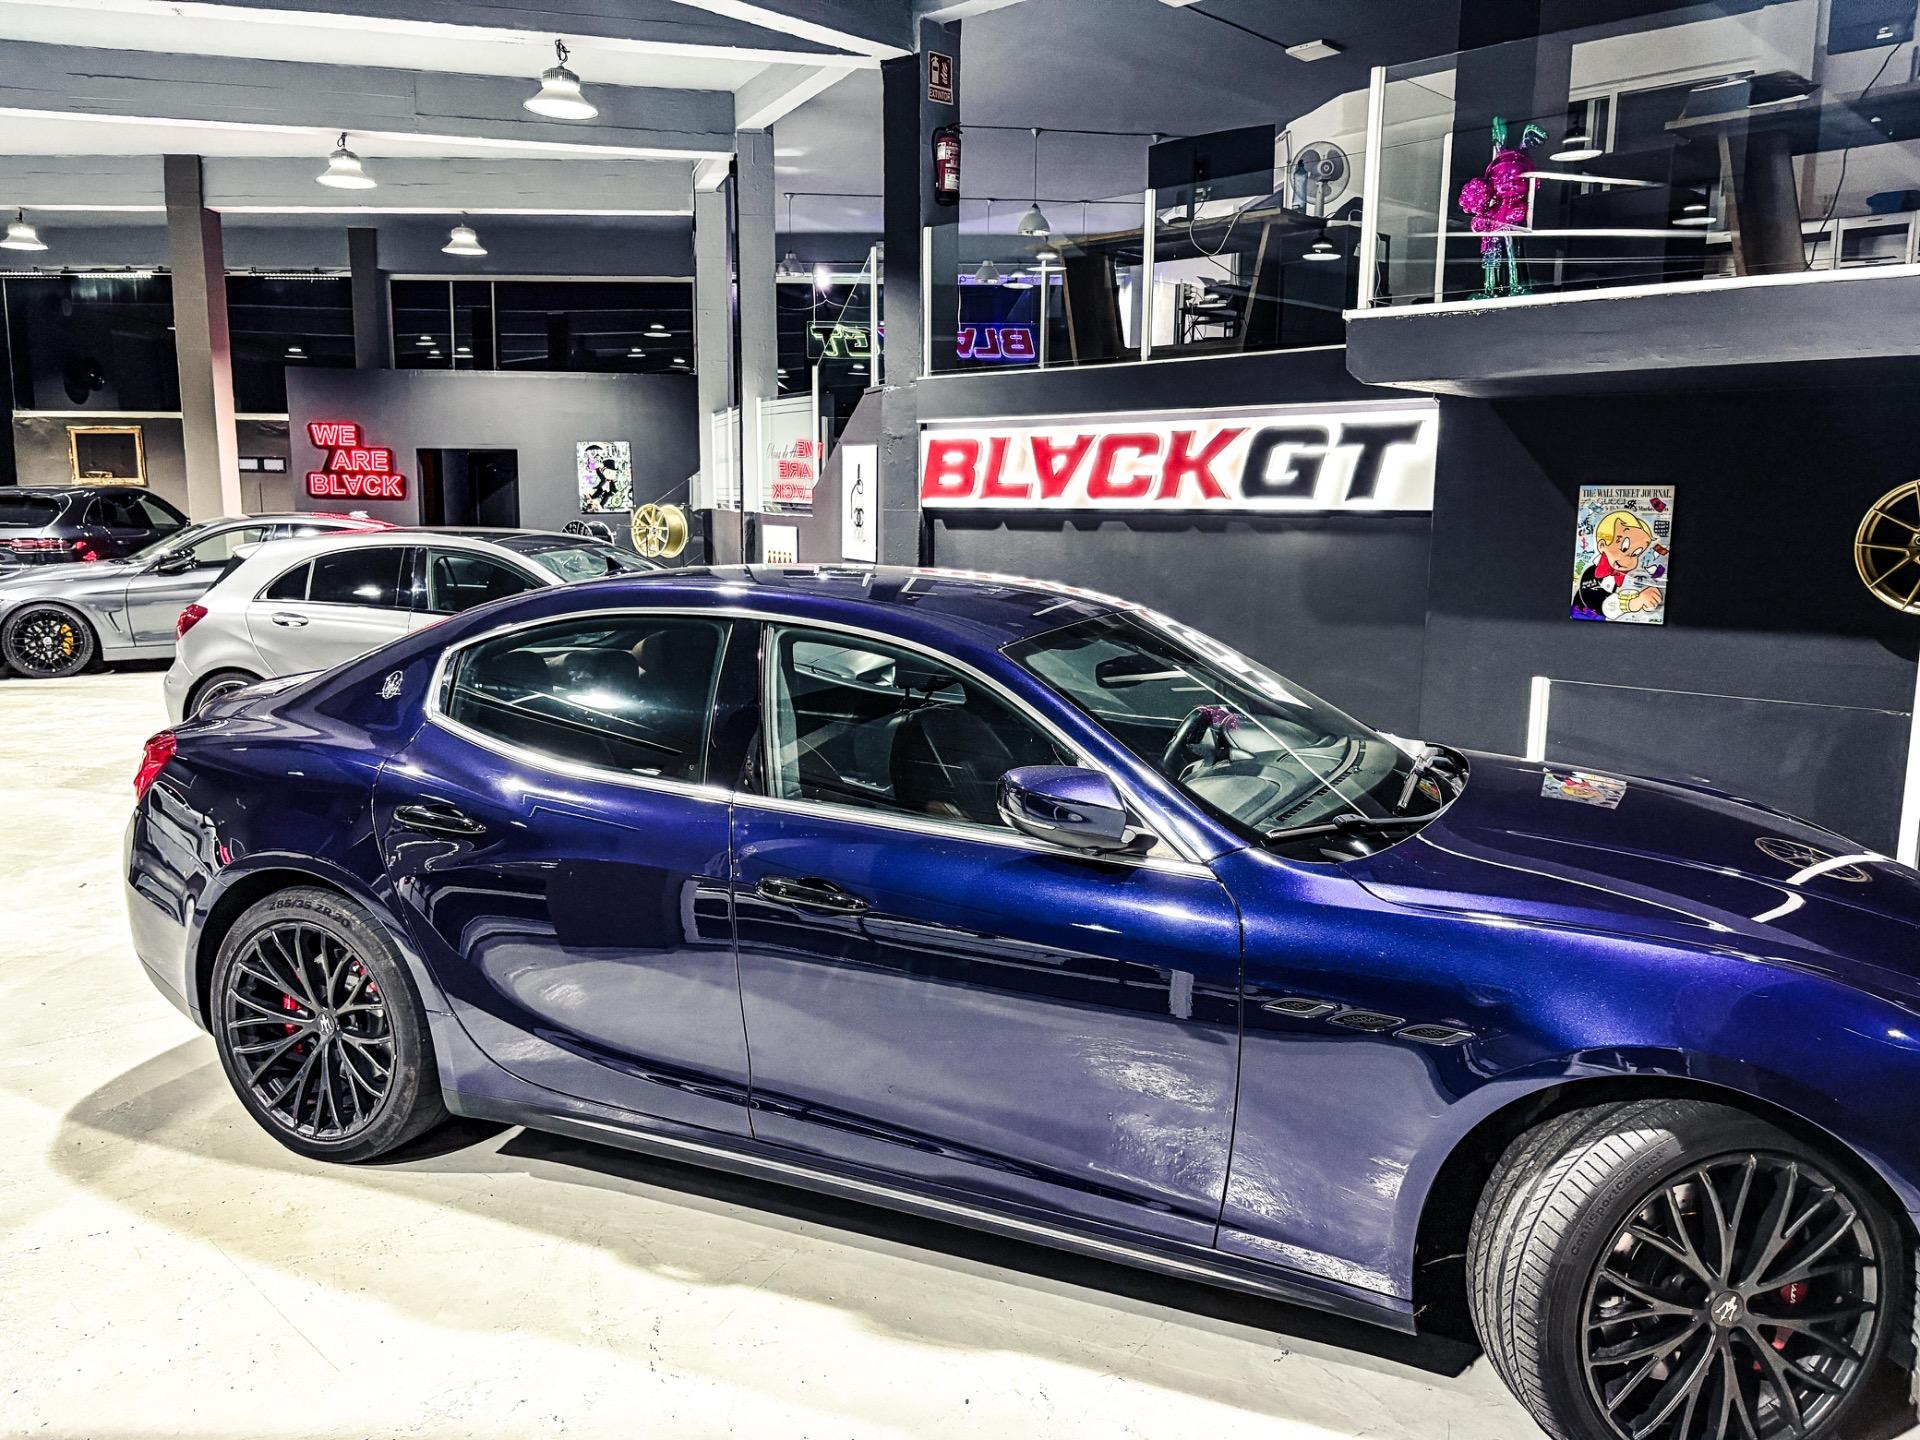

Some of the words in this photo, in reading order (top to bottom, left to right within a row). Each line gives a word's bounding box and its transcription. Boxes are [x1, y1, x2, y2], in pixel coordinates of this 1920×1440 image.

[929, 89, 951, 101] EXTINTOR
[310, 424, 356, 446] WE
[331, 449, 389, 471] ARE
[310, 473, 403, 497] BLACK
[1583, 488, 1597, 498] THE
[1597, 488, 1614, 498] WALL
[1614, 488, 1640, 498] STREET
